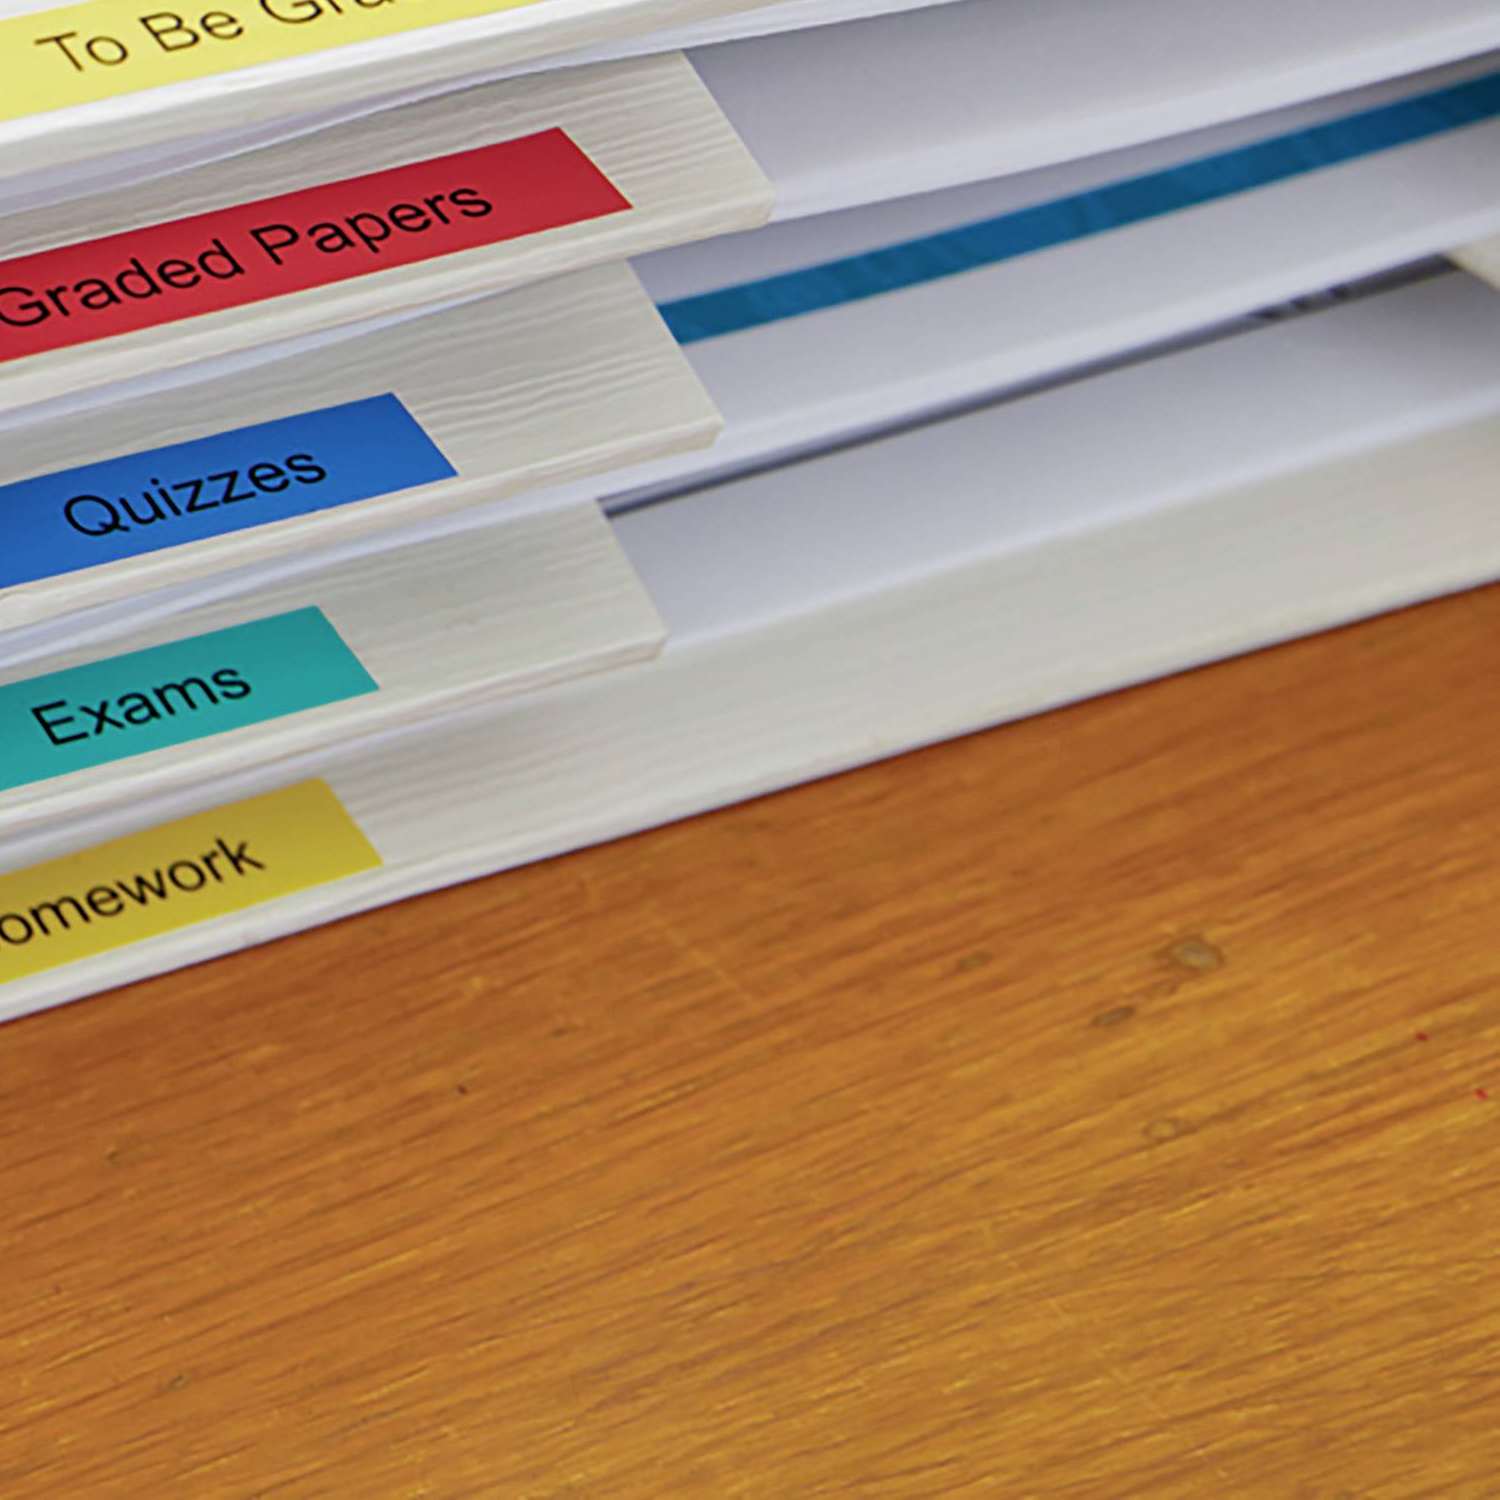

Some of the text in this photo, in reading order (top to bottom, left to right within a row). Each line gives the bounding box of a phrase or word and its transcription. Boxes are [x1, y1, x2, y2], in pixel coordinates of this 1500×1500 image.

[36, 32, 128, 74] To
[140, 11, 243, 53] Be
[249, 186, 493, 266] Papers
[63, 451, 327, 538] Quizzes
[31, 668, 252, 746] Exams
